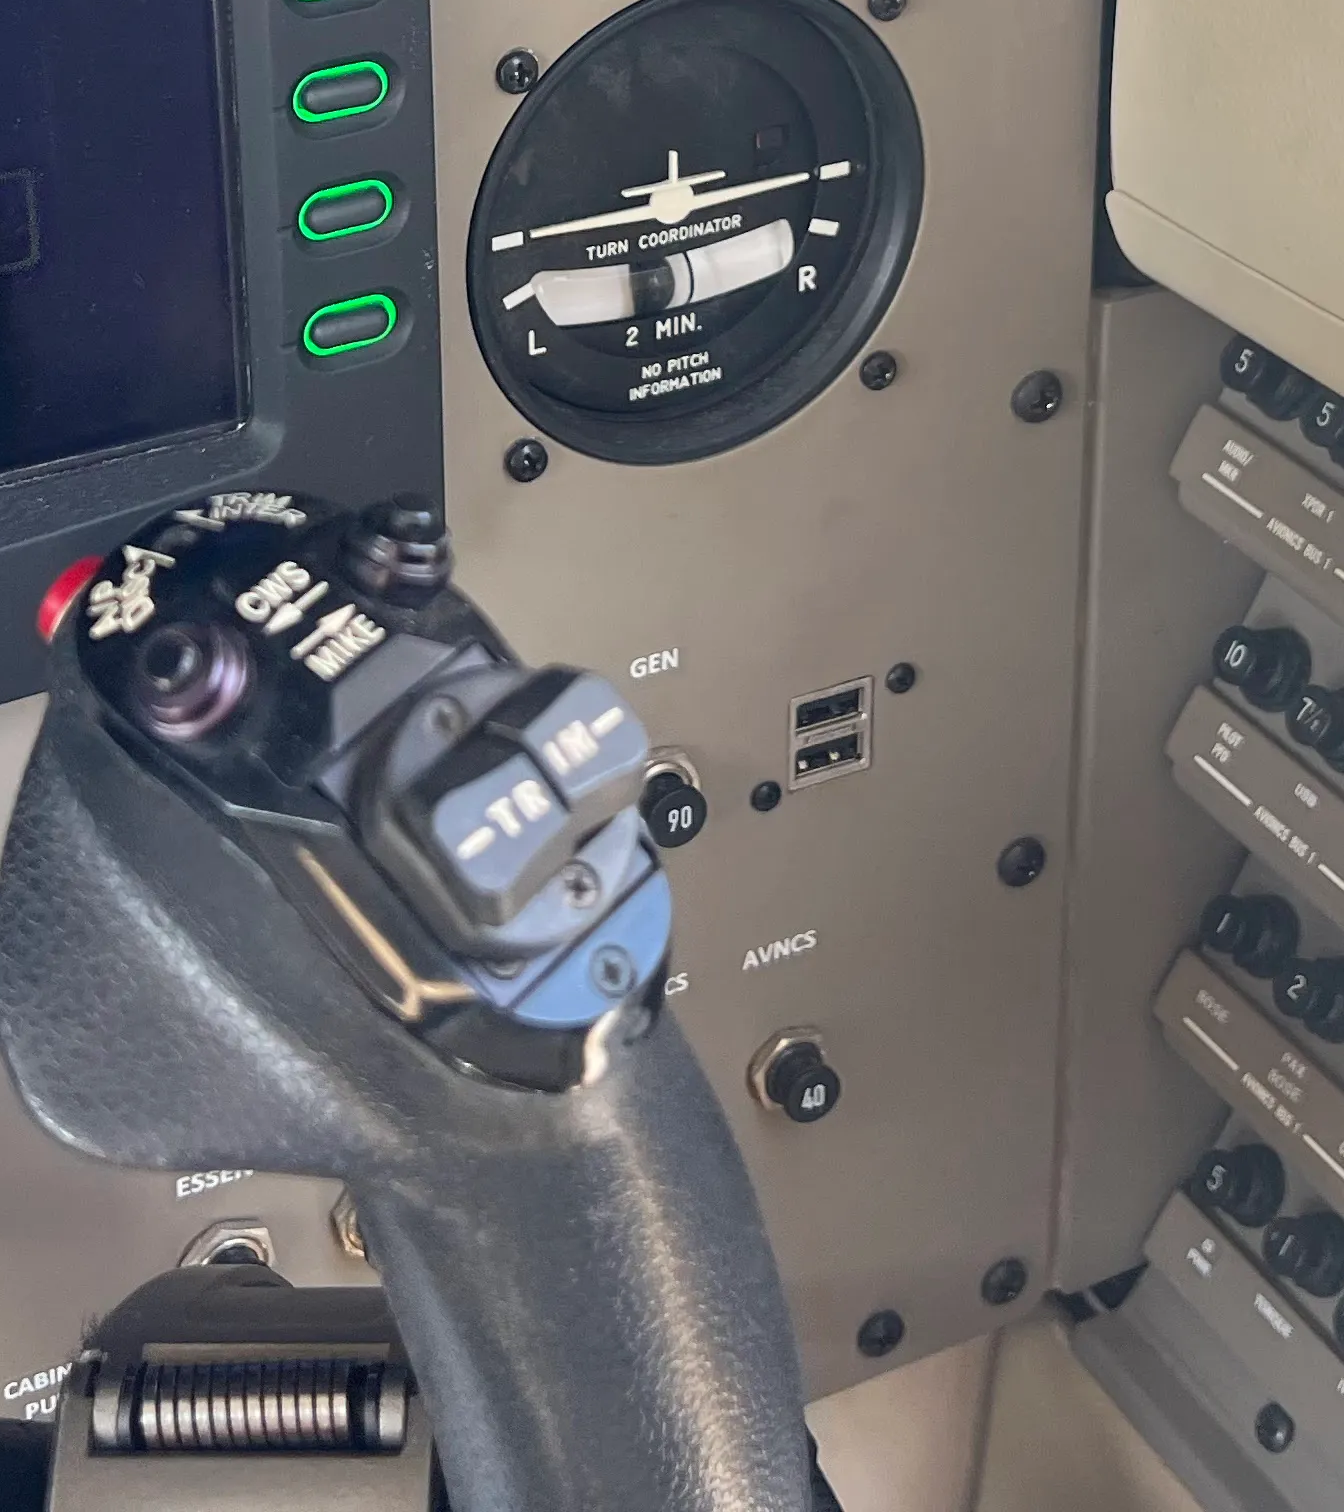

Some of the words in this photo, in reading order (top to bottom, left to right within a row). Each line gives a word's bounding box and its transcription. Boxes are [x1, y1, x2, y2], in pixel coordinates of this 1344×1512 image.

[586, 239, 629, 261] TURN
[638, 214, 742, 250] COORDINATOR
[798, 266, 816, 291] R
[528, 330, 547, 356] L
[626, 326, 638, 347] 2
[656, 313, 702, 340] MIN.
[641, 363, 661, 379] NO
[667, 352, 709, 371] PITCH
[1235, 349, 1253, 373] 5
[629, 368, 722, 401] INFORMATION
[1316, 402, 1336, 426] 5
[235, 561, 310, 623] CWS
[305, 614, 386, 681] MIKE
[1225, 640, 1247, 667] 10
[630, 648, 679, 678] GEN
[668, 806, 692, 832] 90
[742, 930, 817, 971] AVNCS
[1287, 974, 1308, 1002] 2
[802, 1084, 825, 1109] 40
[4, 1362, 72, 1399] CABIN
